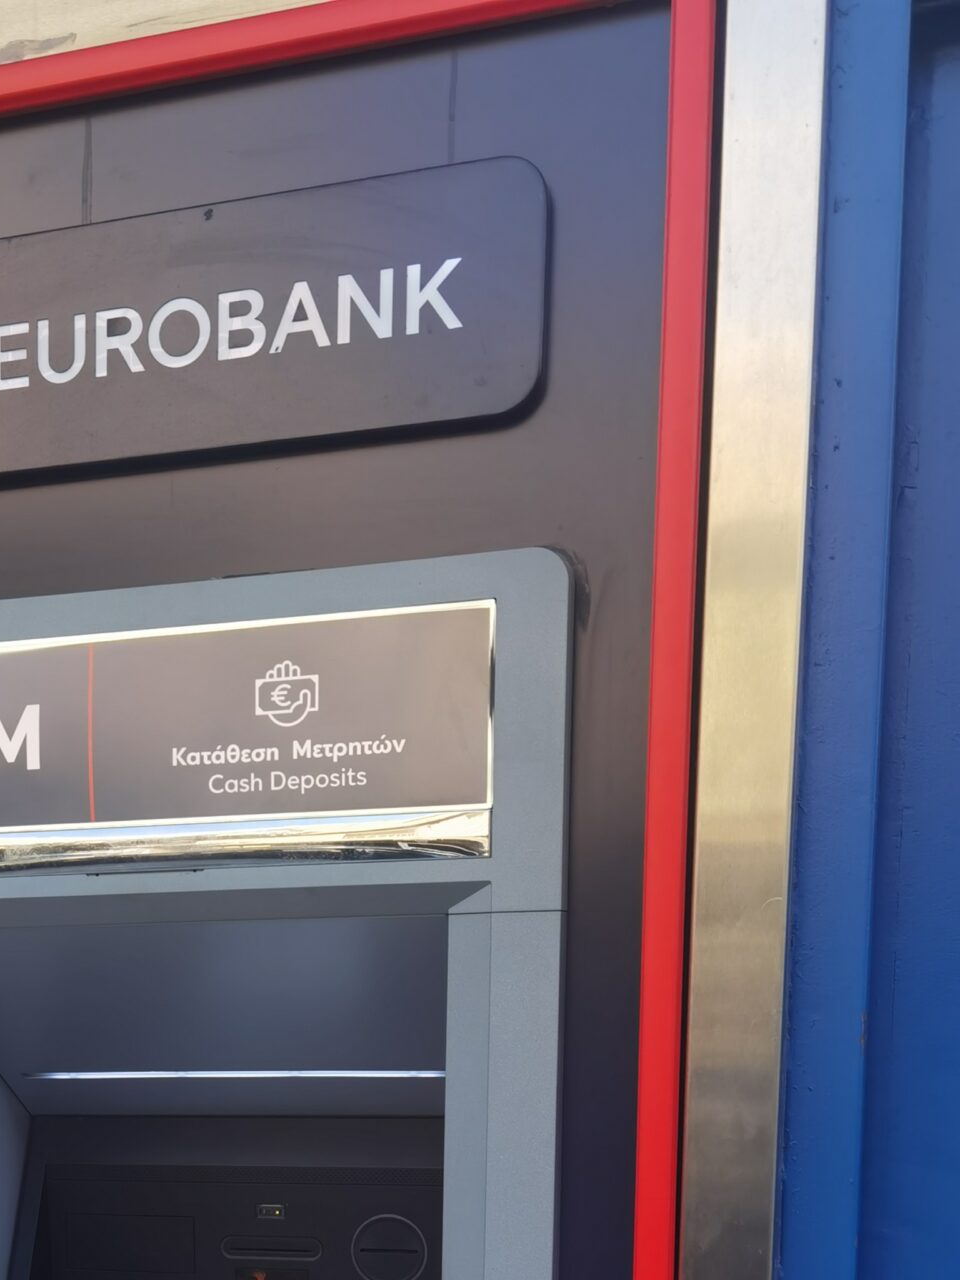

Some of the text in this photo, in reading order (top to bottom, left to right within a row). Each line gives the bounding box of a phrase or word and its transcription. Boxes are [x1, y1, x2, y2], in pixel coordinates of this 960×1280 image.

[171, 734, 406, 767] Κατάθεση Μετρητών
[208, 766, 368, 795] Cash Deposits
